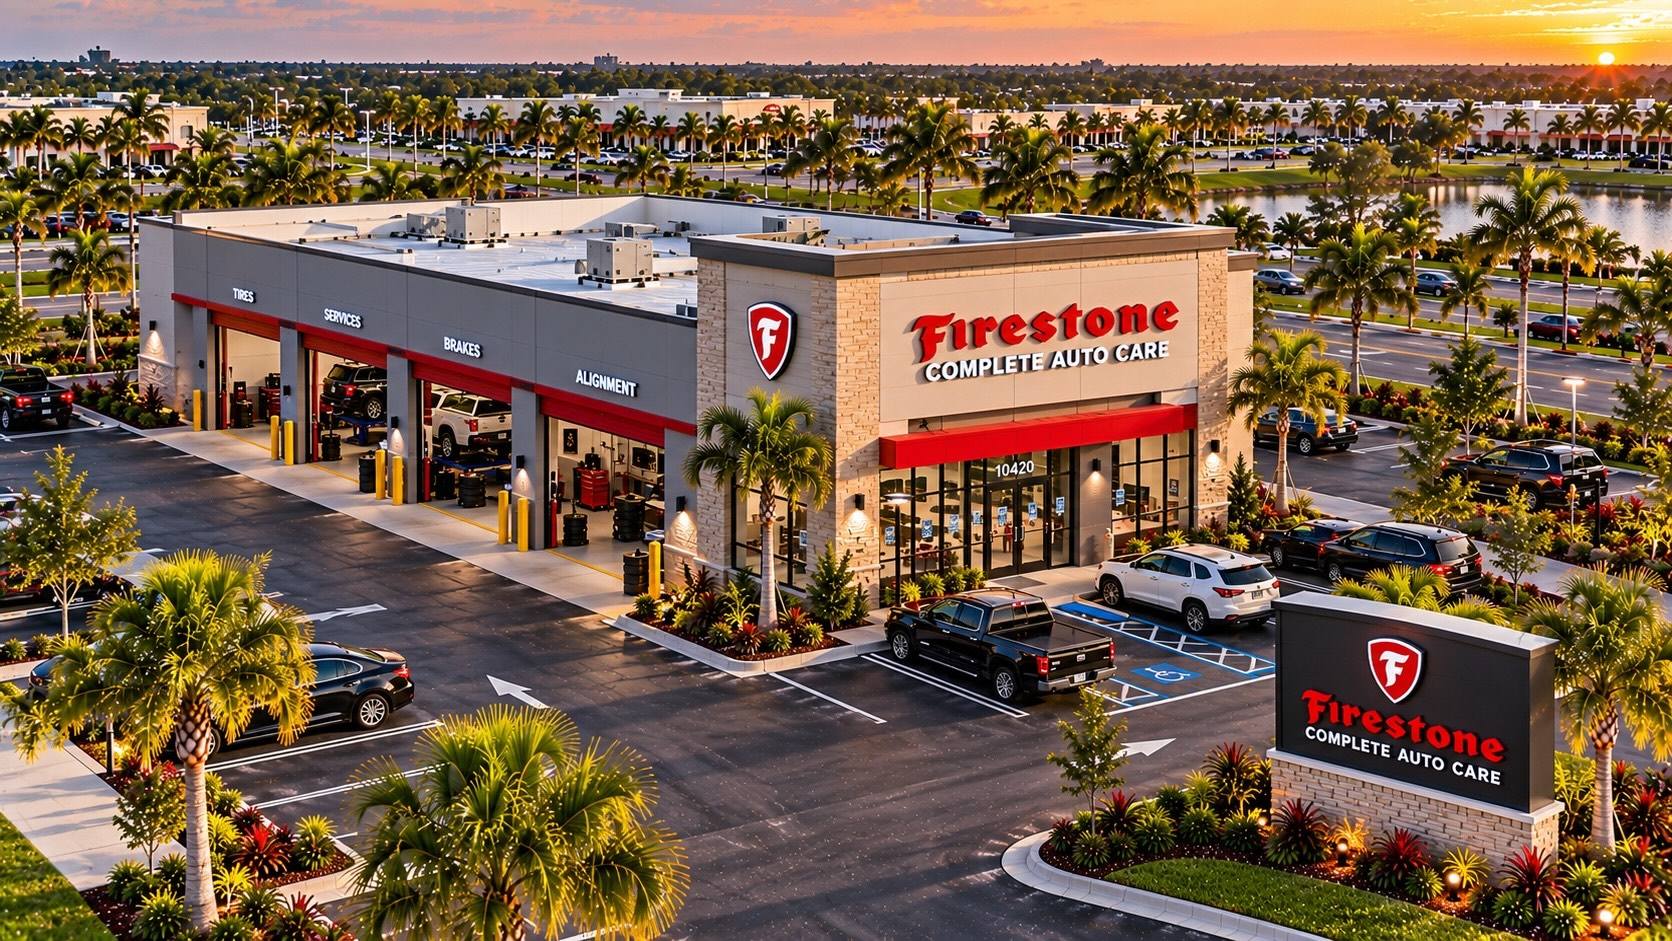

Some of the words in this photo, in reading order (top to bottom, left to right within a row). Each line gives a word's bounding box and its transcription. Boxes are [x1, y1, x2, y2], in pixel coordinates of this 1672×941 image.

[232, 287, 255, 303] TIRES
[323, 308, 362, 329] SERVICES
[911, 300, 1180, 364] Firestone
[443, 336, 481, 358] BRAKES
[756, 317, 782, 361] F
[925, 352, 1045, 382] COMPLETE
[1051, 346, 1109, 369] AUTO
[1115, 340, 1170, 362] CARE
[575, 369, 637, 397] ALIGNMENT
[994, 460, 1035, 478] 10420
[1378, 650, 1410, 688] F
[1301, 689, 1505, 763] Firestone
[1305, 726, 1391, 758] COMPLETE
[1397, 748, 1445, 771] AUTO
[1451, 761, 1501, 786] CARE
